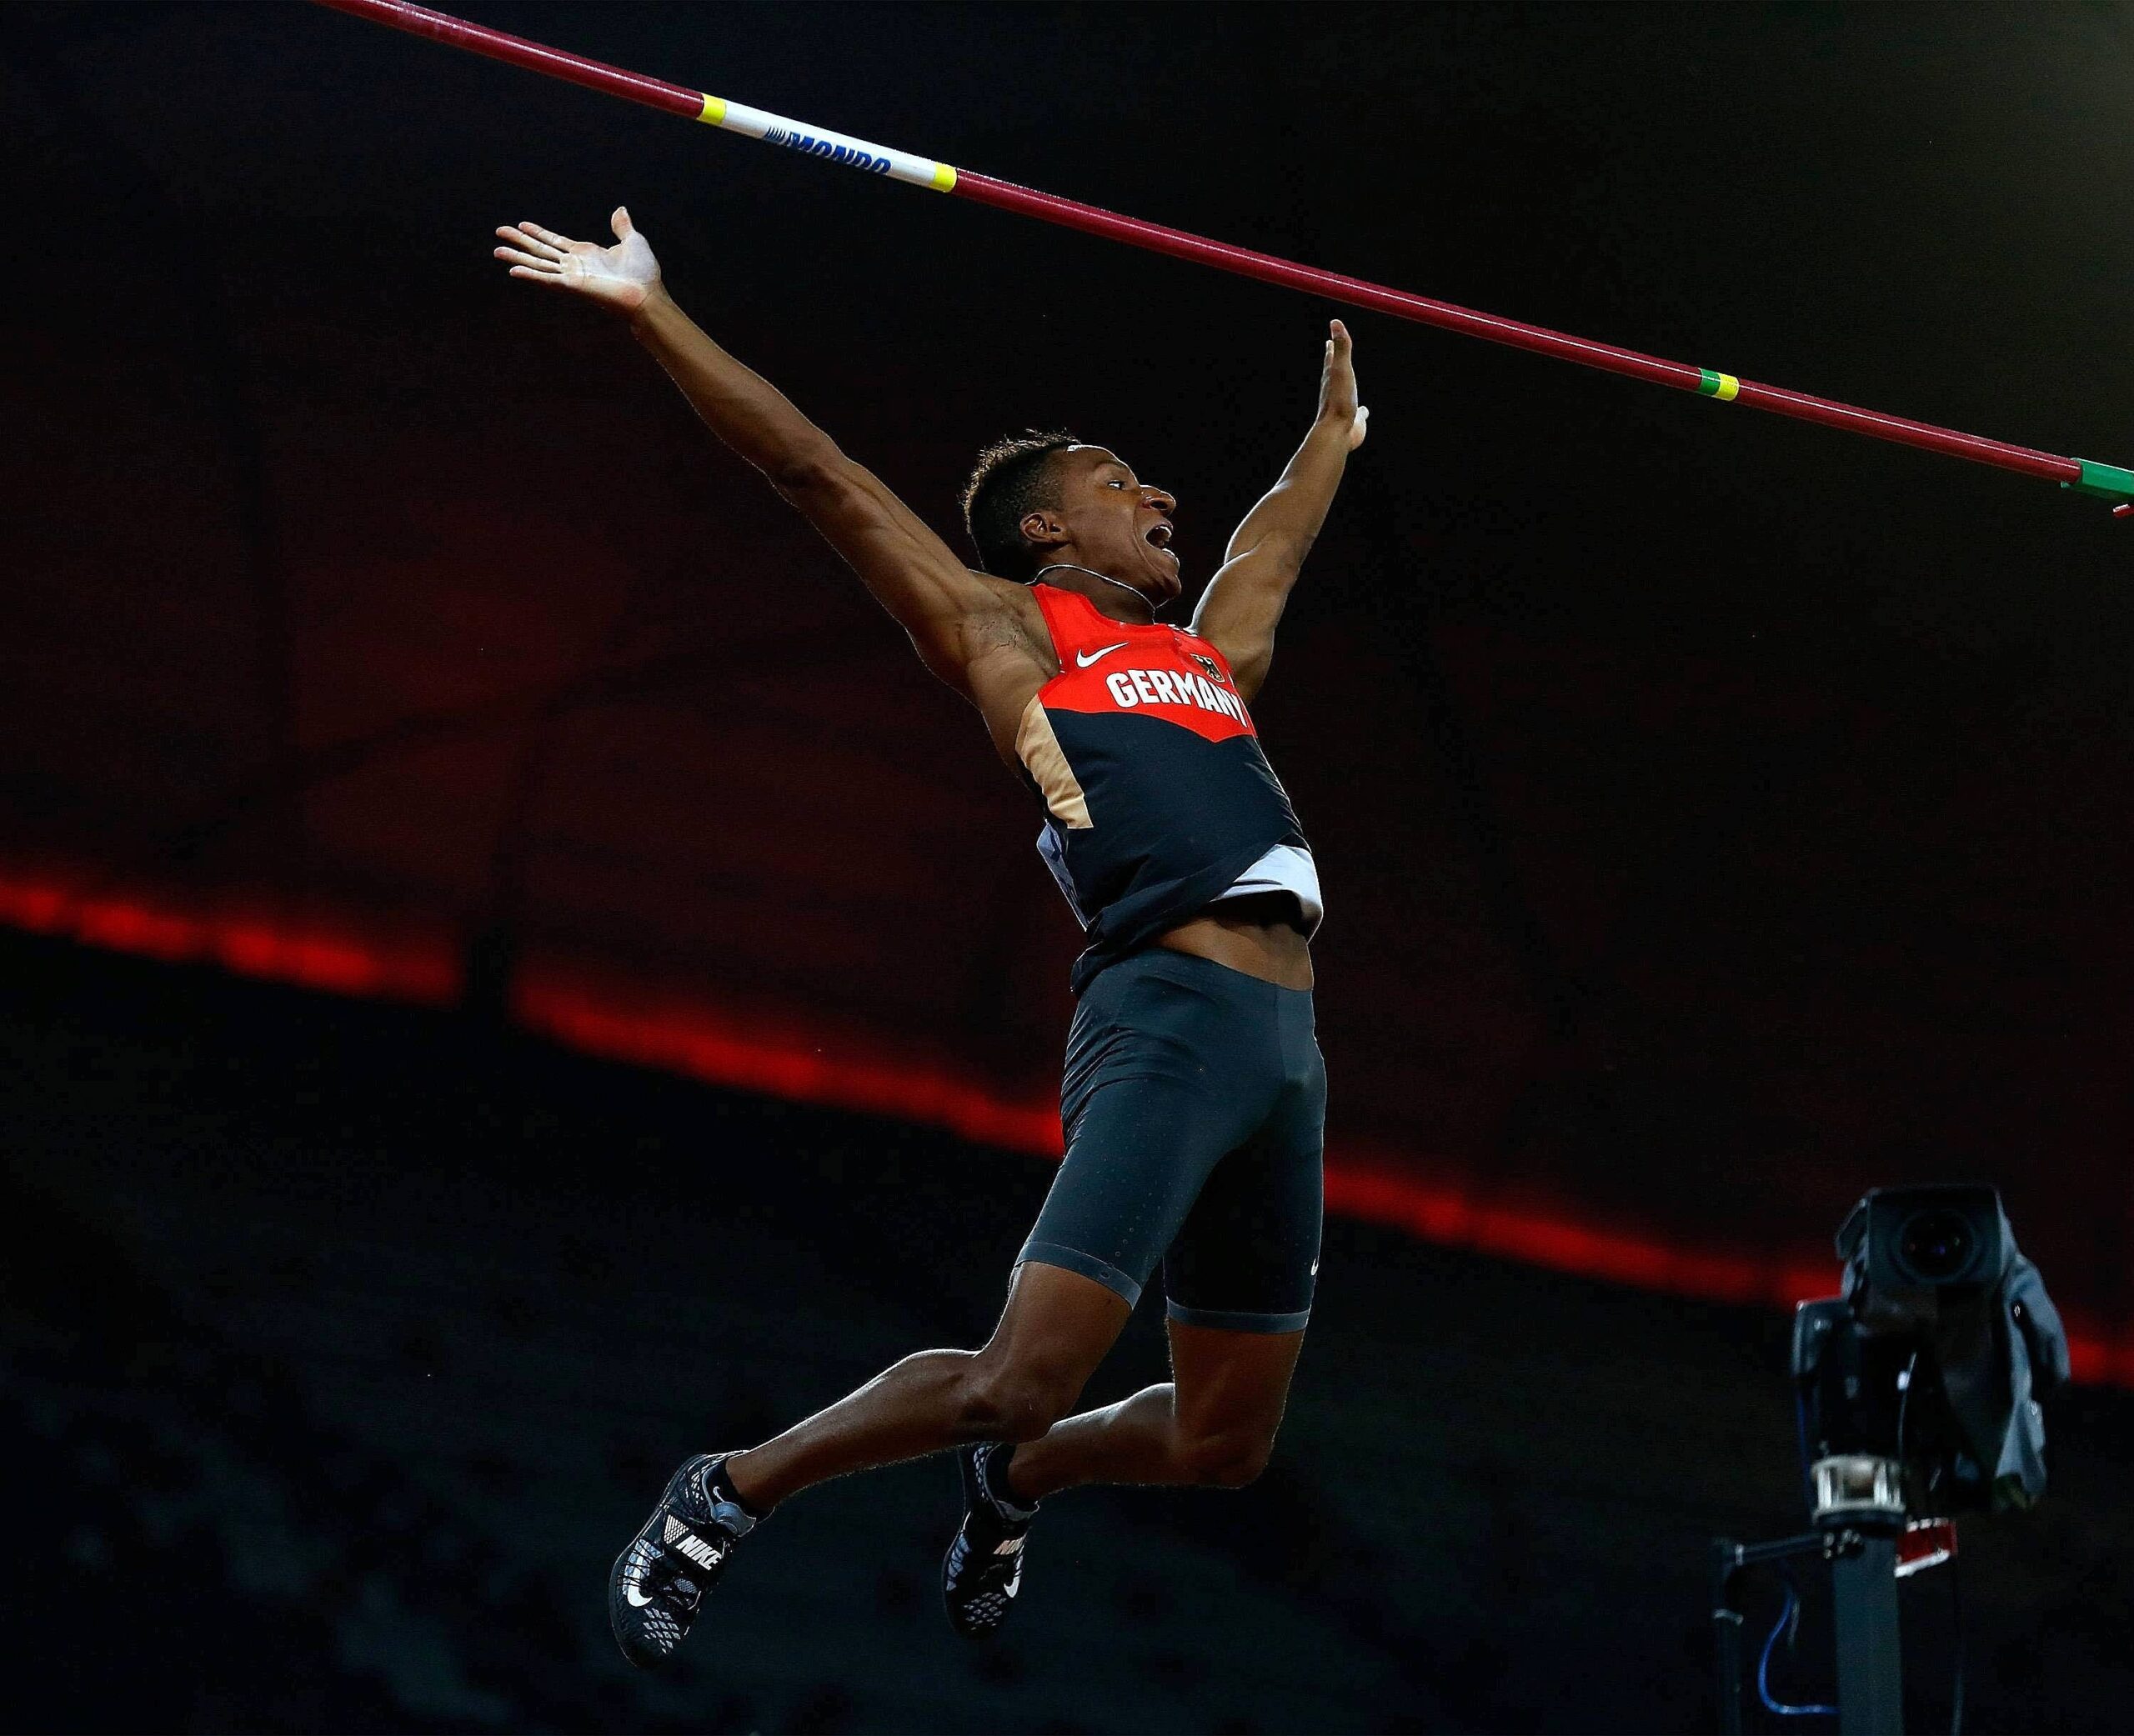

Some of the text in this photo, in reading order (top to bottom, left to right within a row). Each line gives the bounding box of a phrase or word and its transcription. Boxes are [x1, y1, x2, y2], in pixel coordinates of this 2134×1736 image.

[788, 132, 891, 174] MONDO
[1107, 669, 1247, 728] GERMANY
[676, 1535, 722, 1570] NIKE
